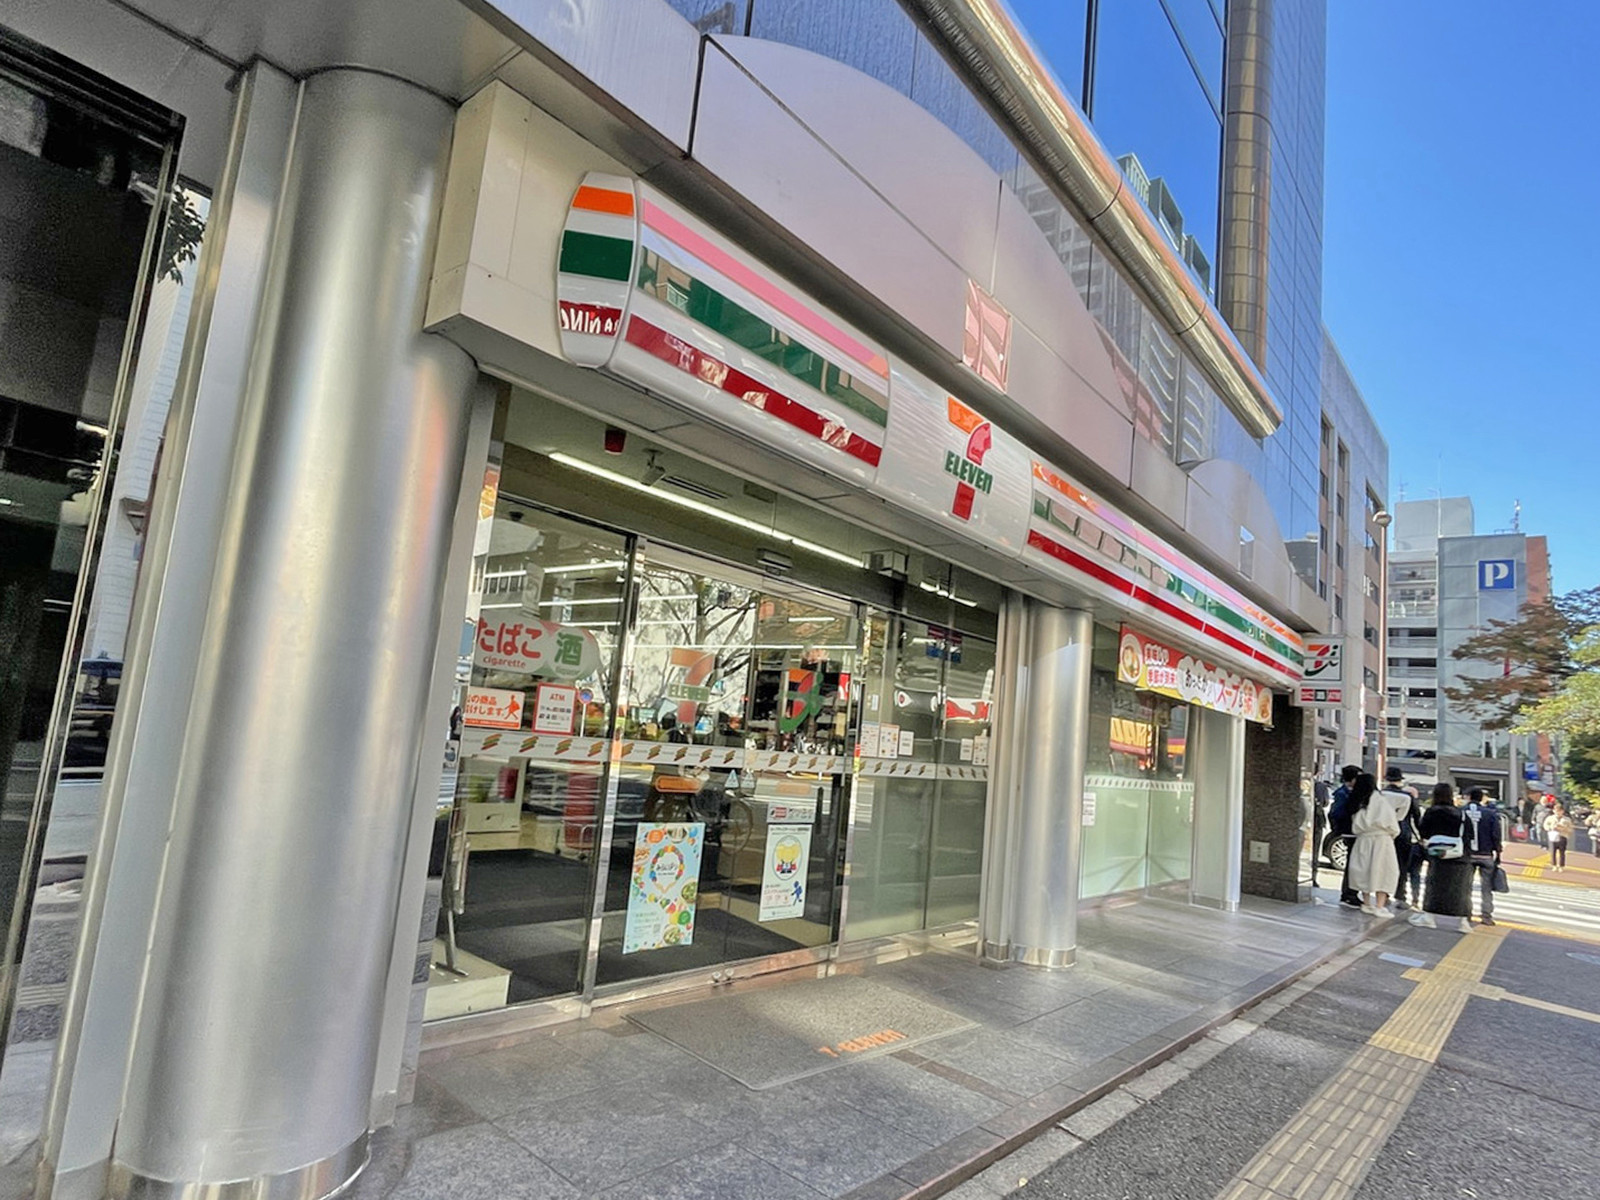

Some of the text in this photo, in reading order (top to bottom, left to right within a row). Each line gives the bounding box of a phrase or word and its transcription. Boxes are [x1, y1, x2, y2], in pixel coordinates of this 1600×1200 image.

[1484, 563, 1509, 587] P
[477, 617, 584, 666] たばこ 酒
[483, 655, 526, 668] cigarette
[549, 693, 565, 702] ATM
